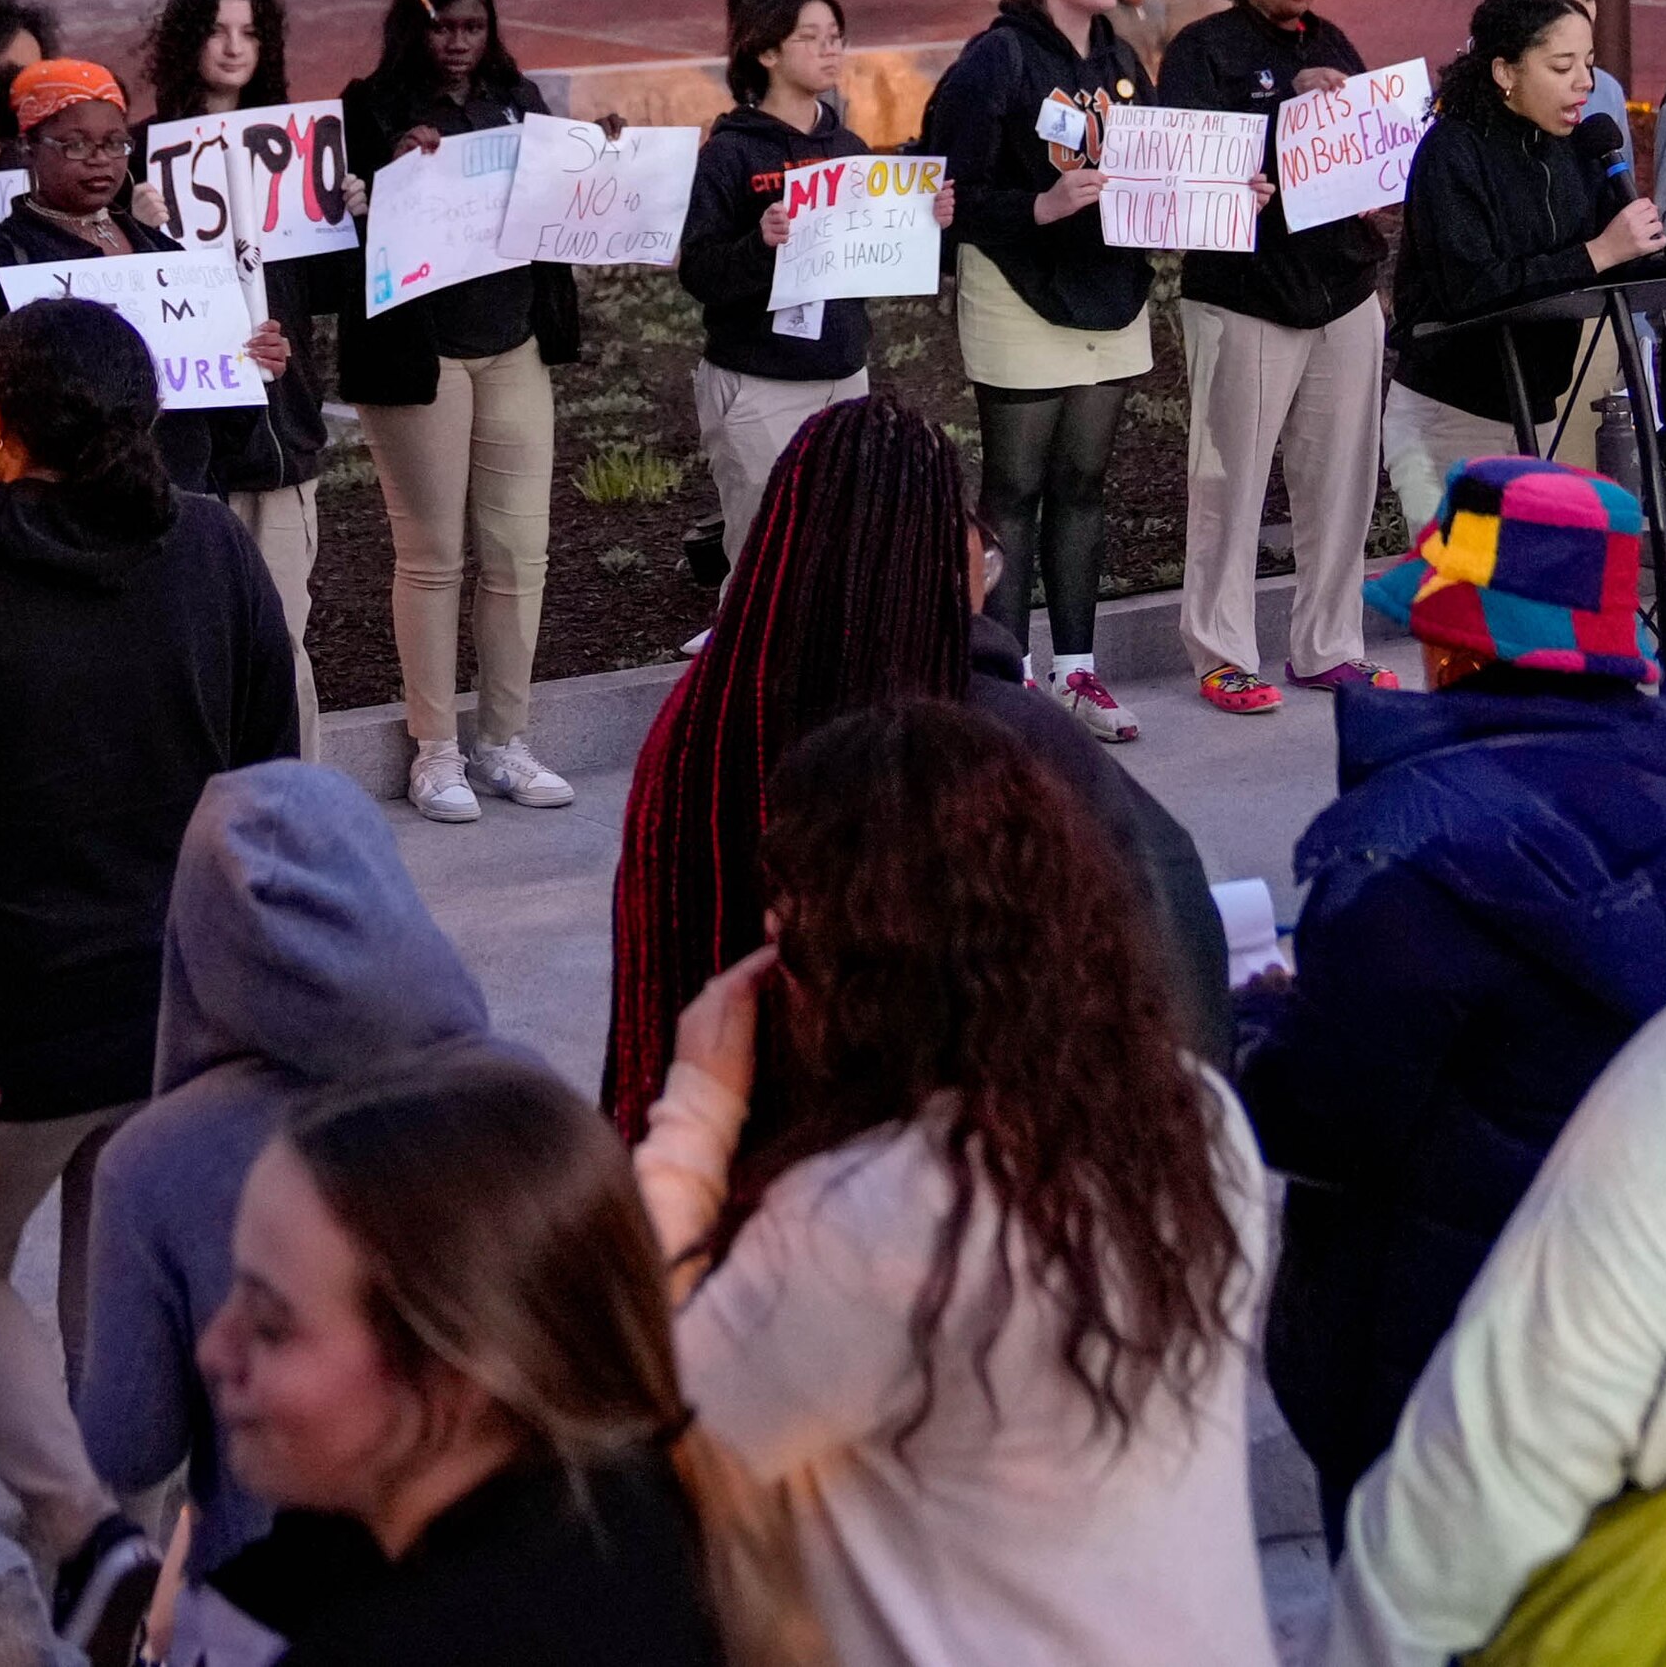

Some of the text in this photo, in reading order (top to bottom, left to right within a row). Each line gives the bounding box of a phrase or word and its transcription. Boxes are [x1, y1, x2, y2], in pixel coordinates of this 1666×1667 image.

[1107, 108, 1265, 135] BUDGET CUTS ARE THE
[1282, 103, 1309, 141] NO
[1370, 73, 1404, 107] NO
[563, 127, 643, 174] SAY
[1104, 130, 1265, 177] STARVATION
[1282, 146, 1309, 190] NO
[565, 177, 619, 222] NO
[788, 163, 845, 219] MY
[866, 161, 941, 197] OUR
[534, 224, 600, 259] FUND
[844, 209, 873, 232] IS
[883, 208, 915, 230] IN
[1103, 189, 1253, 250] EDUCATION
[52, 271, 145, 299] YOUR
[795, 241, 903, 287] YOUR HANDS
[160, 297, 210, 324] MY
